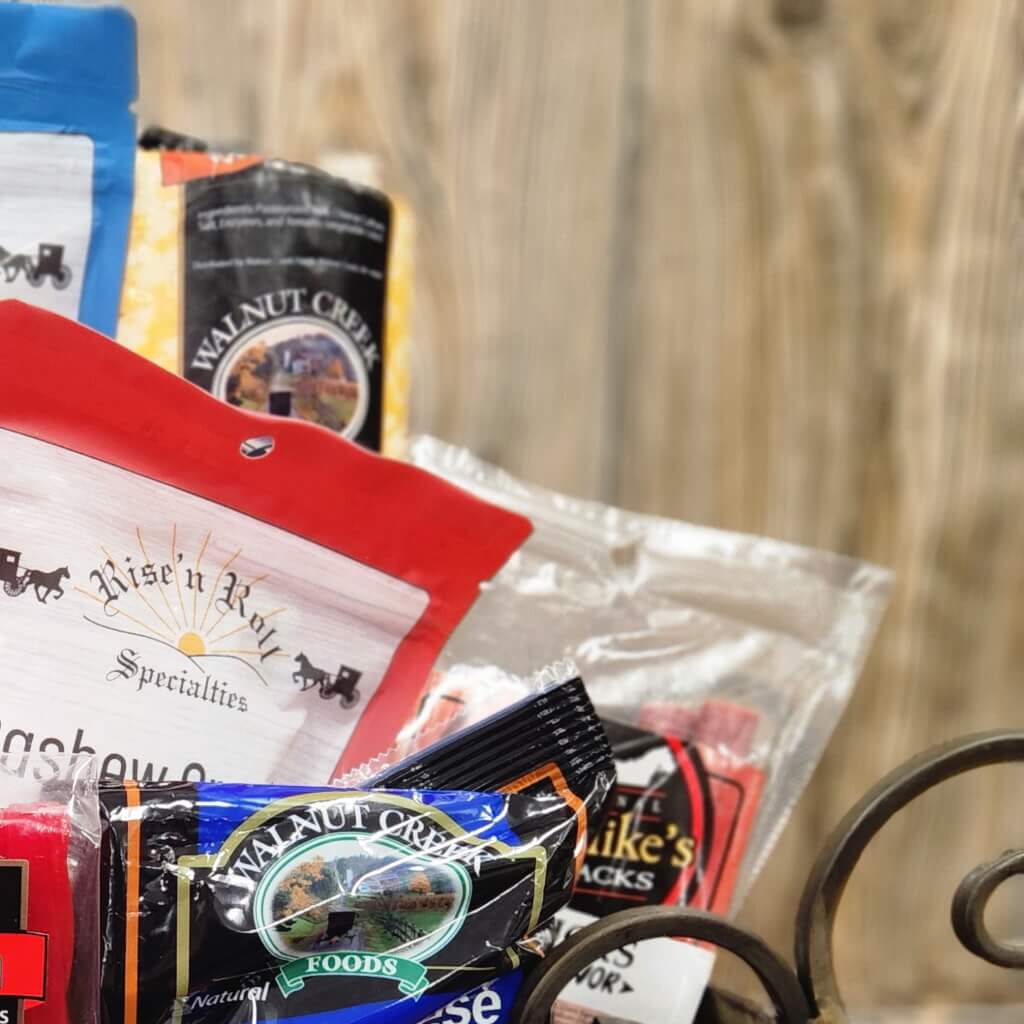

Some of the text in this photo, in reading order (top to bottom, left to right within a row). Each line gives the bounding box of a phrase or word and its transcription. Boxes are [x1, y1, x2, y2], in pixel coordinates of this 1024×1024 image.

[191, 288, 382, 373] WALNUT CREEK
[88, 552, 283, 664] Rise'n Roll
[106, 647, 249, 713] Specialties
[233, 803, 371, 883] WALNUT
[189, 981, 270, 1011] Natural
[305, 954, 399, 976] FOODS
